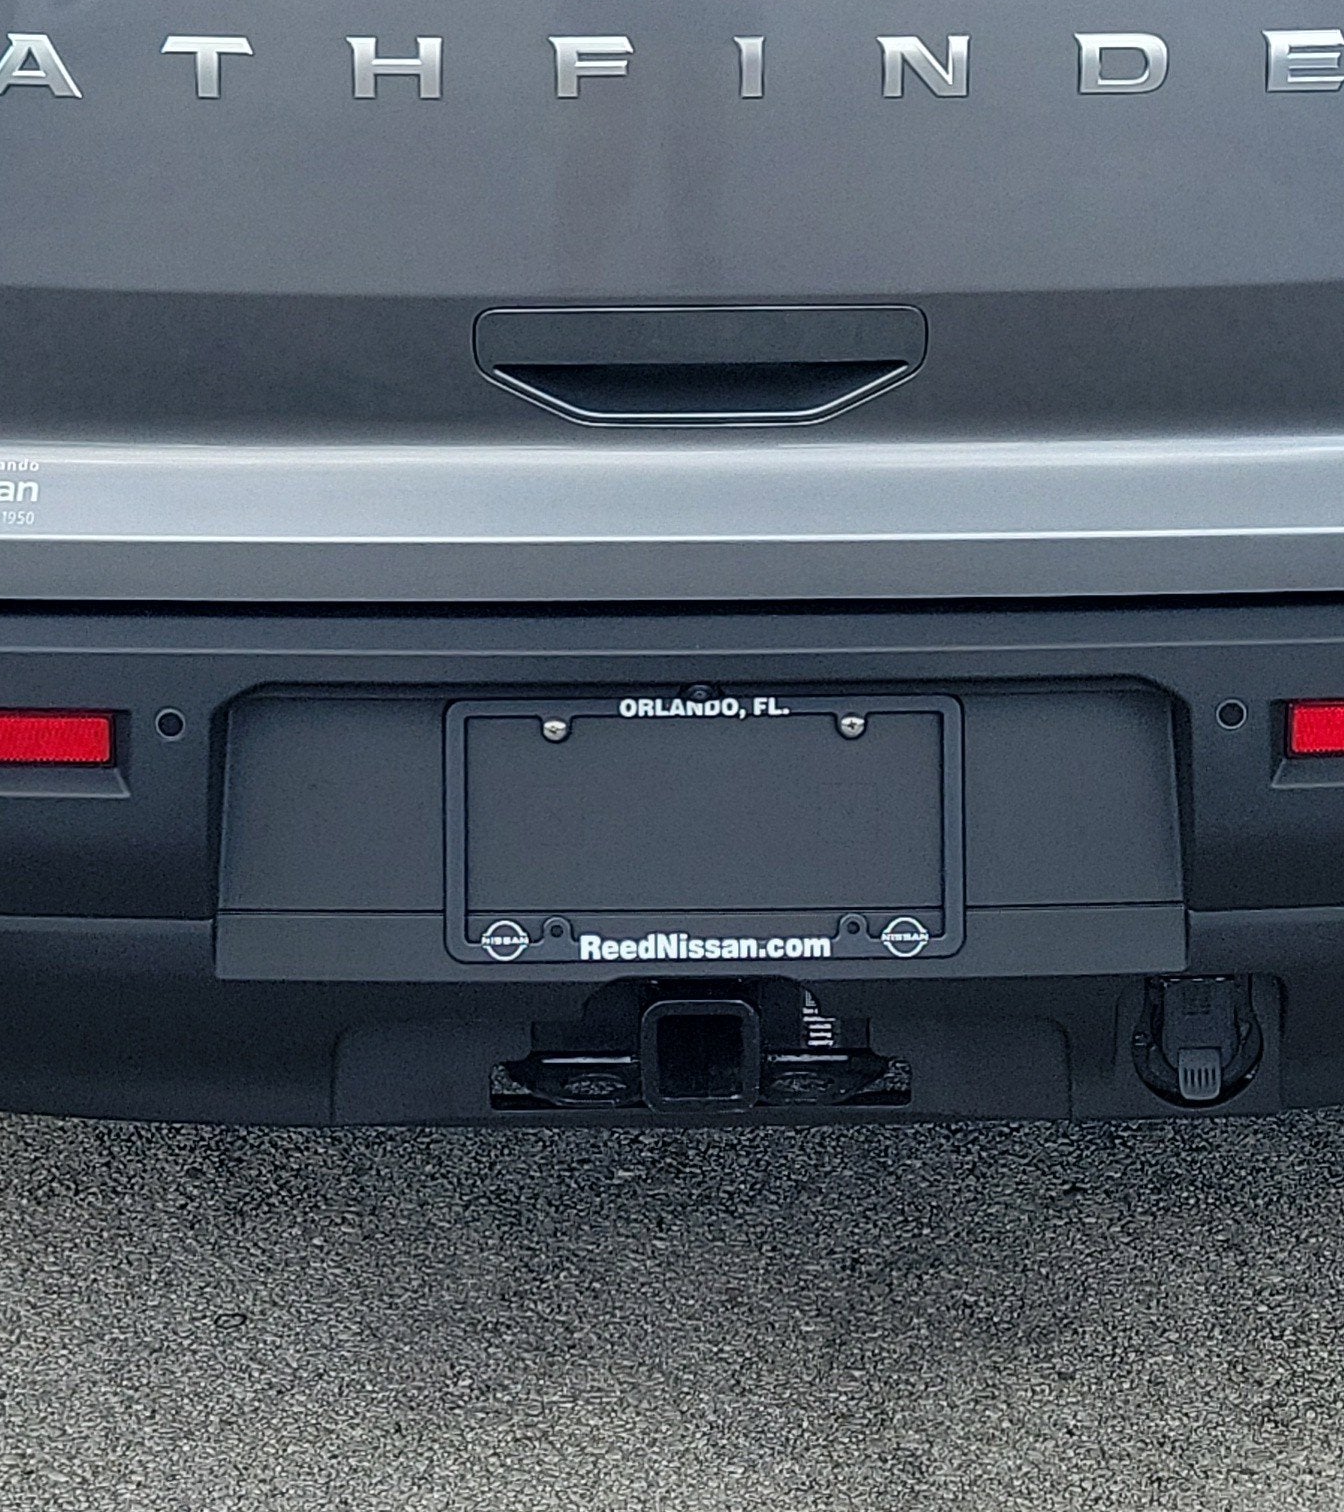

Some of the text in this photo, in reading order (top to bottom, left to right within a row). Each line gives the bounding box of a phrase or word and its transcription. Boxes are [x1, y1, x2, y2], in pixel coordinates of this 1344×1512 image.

[619, 697, 790, 719] ORLANDO, FL.
[579, 933, 831, 961] ReedNissan.com
